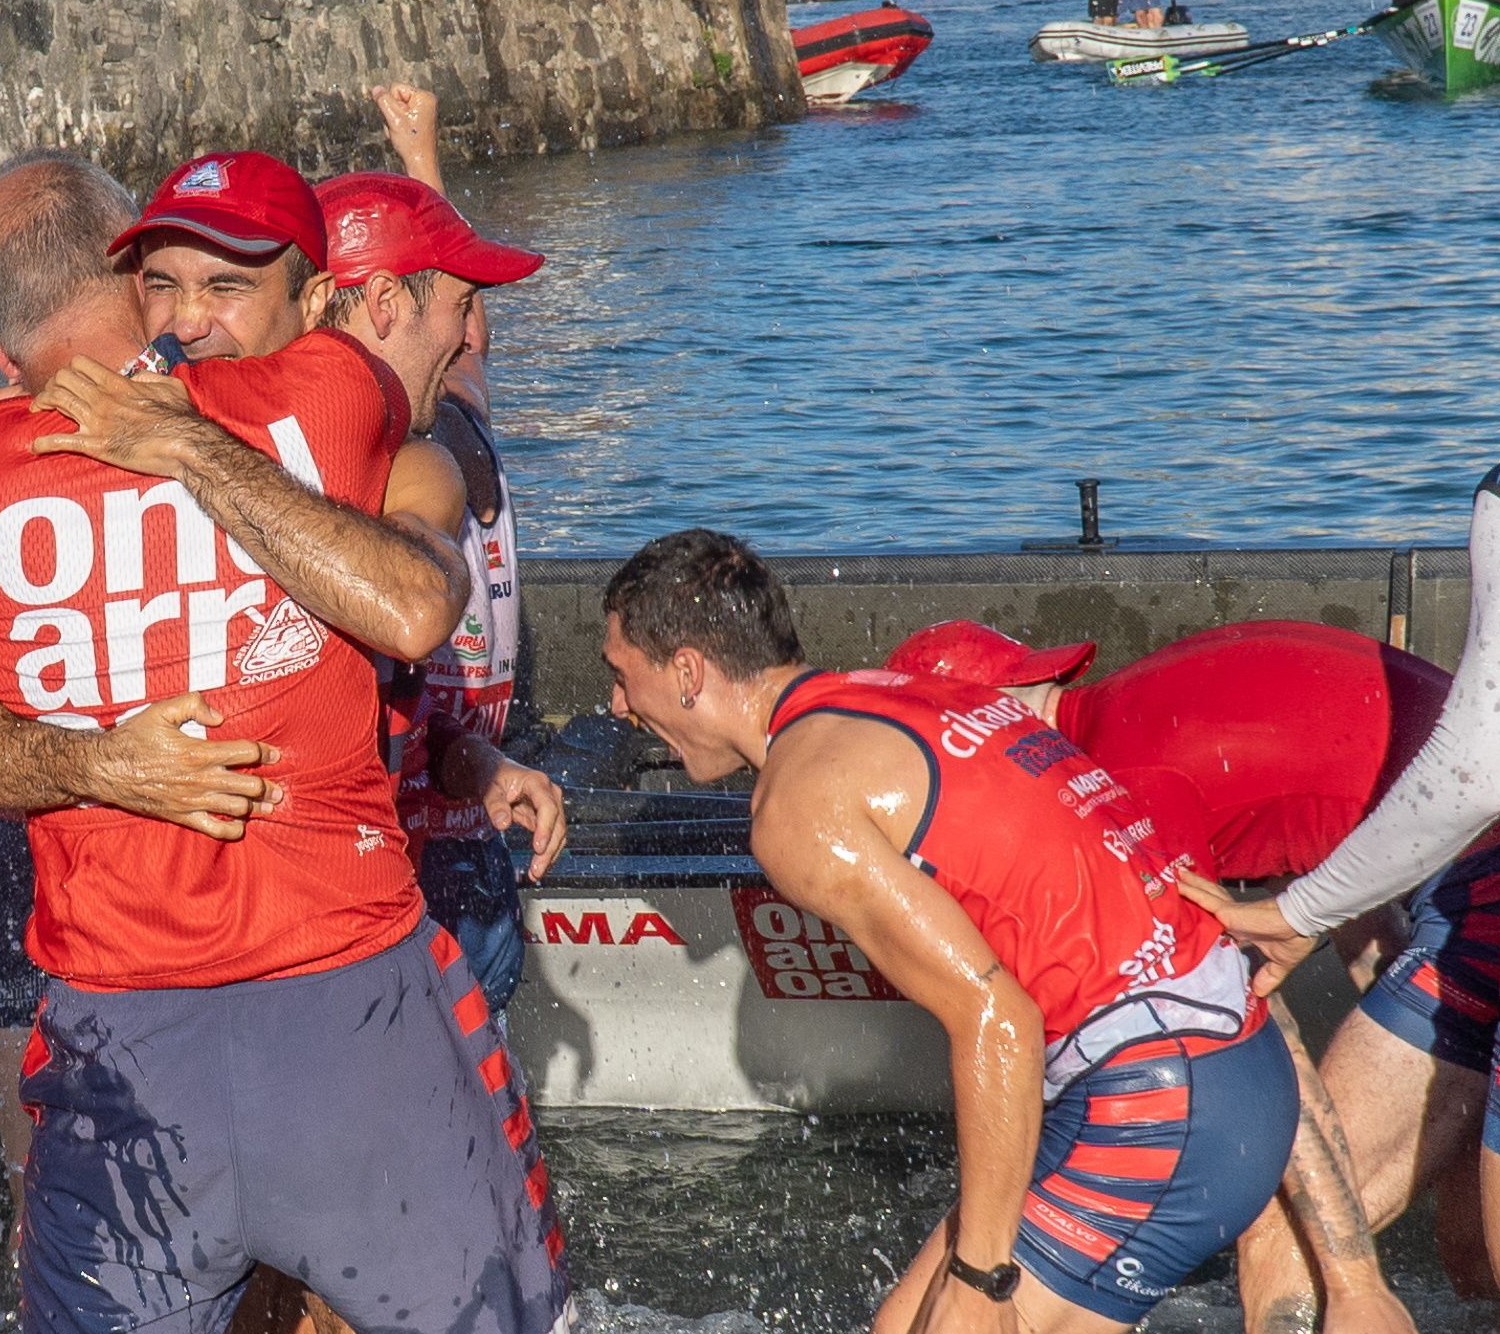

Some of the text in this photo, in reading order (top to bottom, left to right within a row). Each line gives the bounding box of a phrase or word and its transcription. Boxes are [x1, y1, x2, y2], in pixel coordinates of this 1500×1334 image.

[1423, 12, 1438, 37] 23
[1461, 12, 1478, 37] 23
[10, 579, 266, 711] arr
[455, 635, 487, 651] URLA
[239, 657, 320, 685] ONDARROA
[524, 912, 688, 945] MA
[775, 970, 871, 997] oa
[1036, 1203, 1098, 1243] DYALVO
